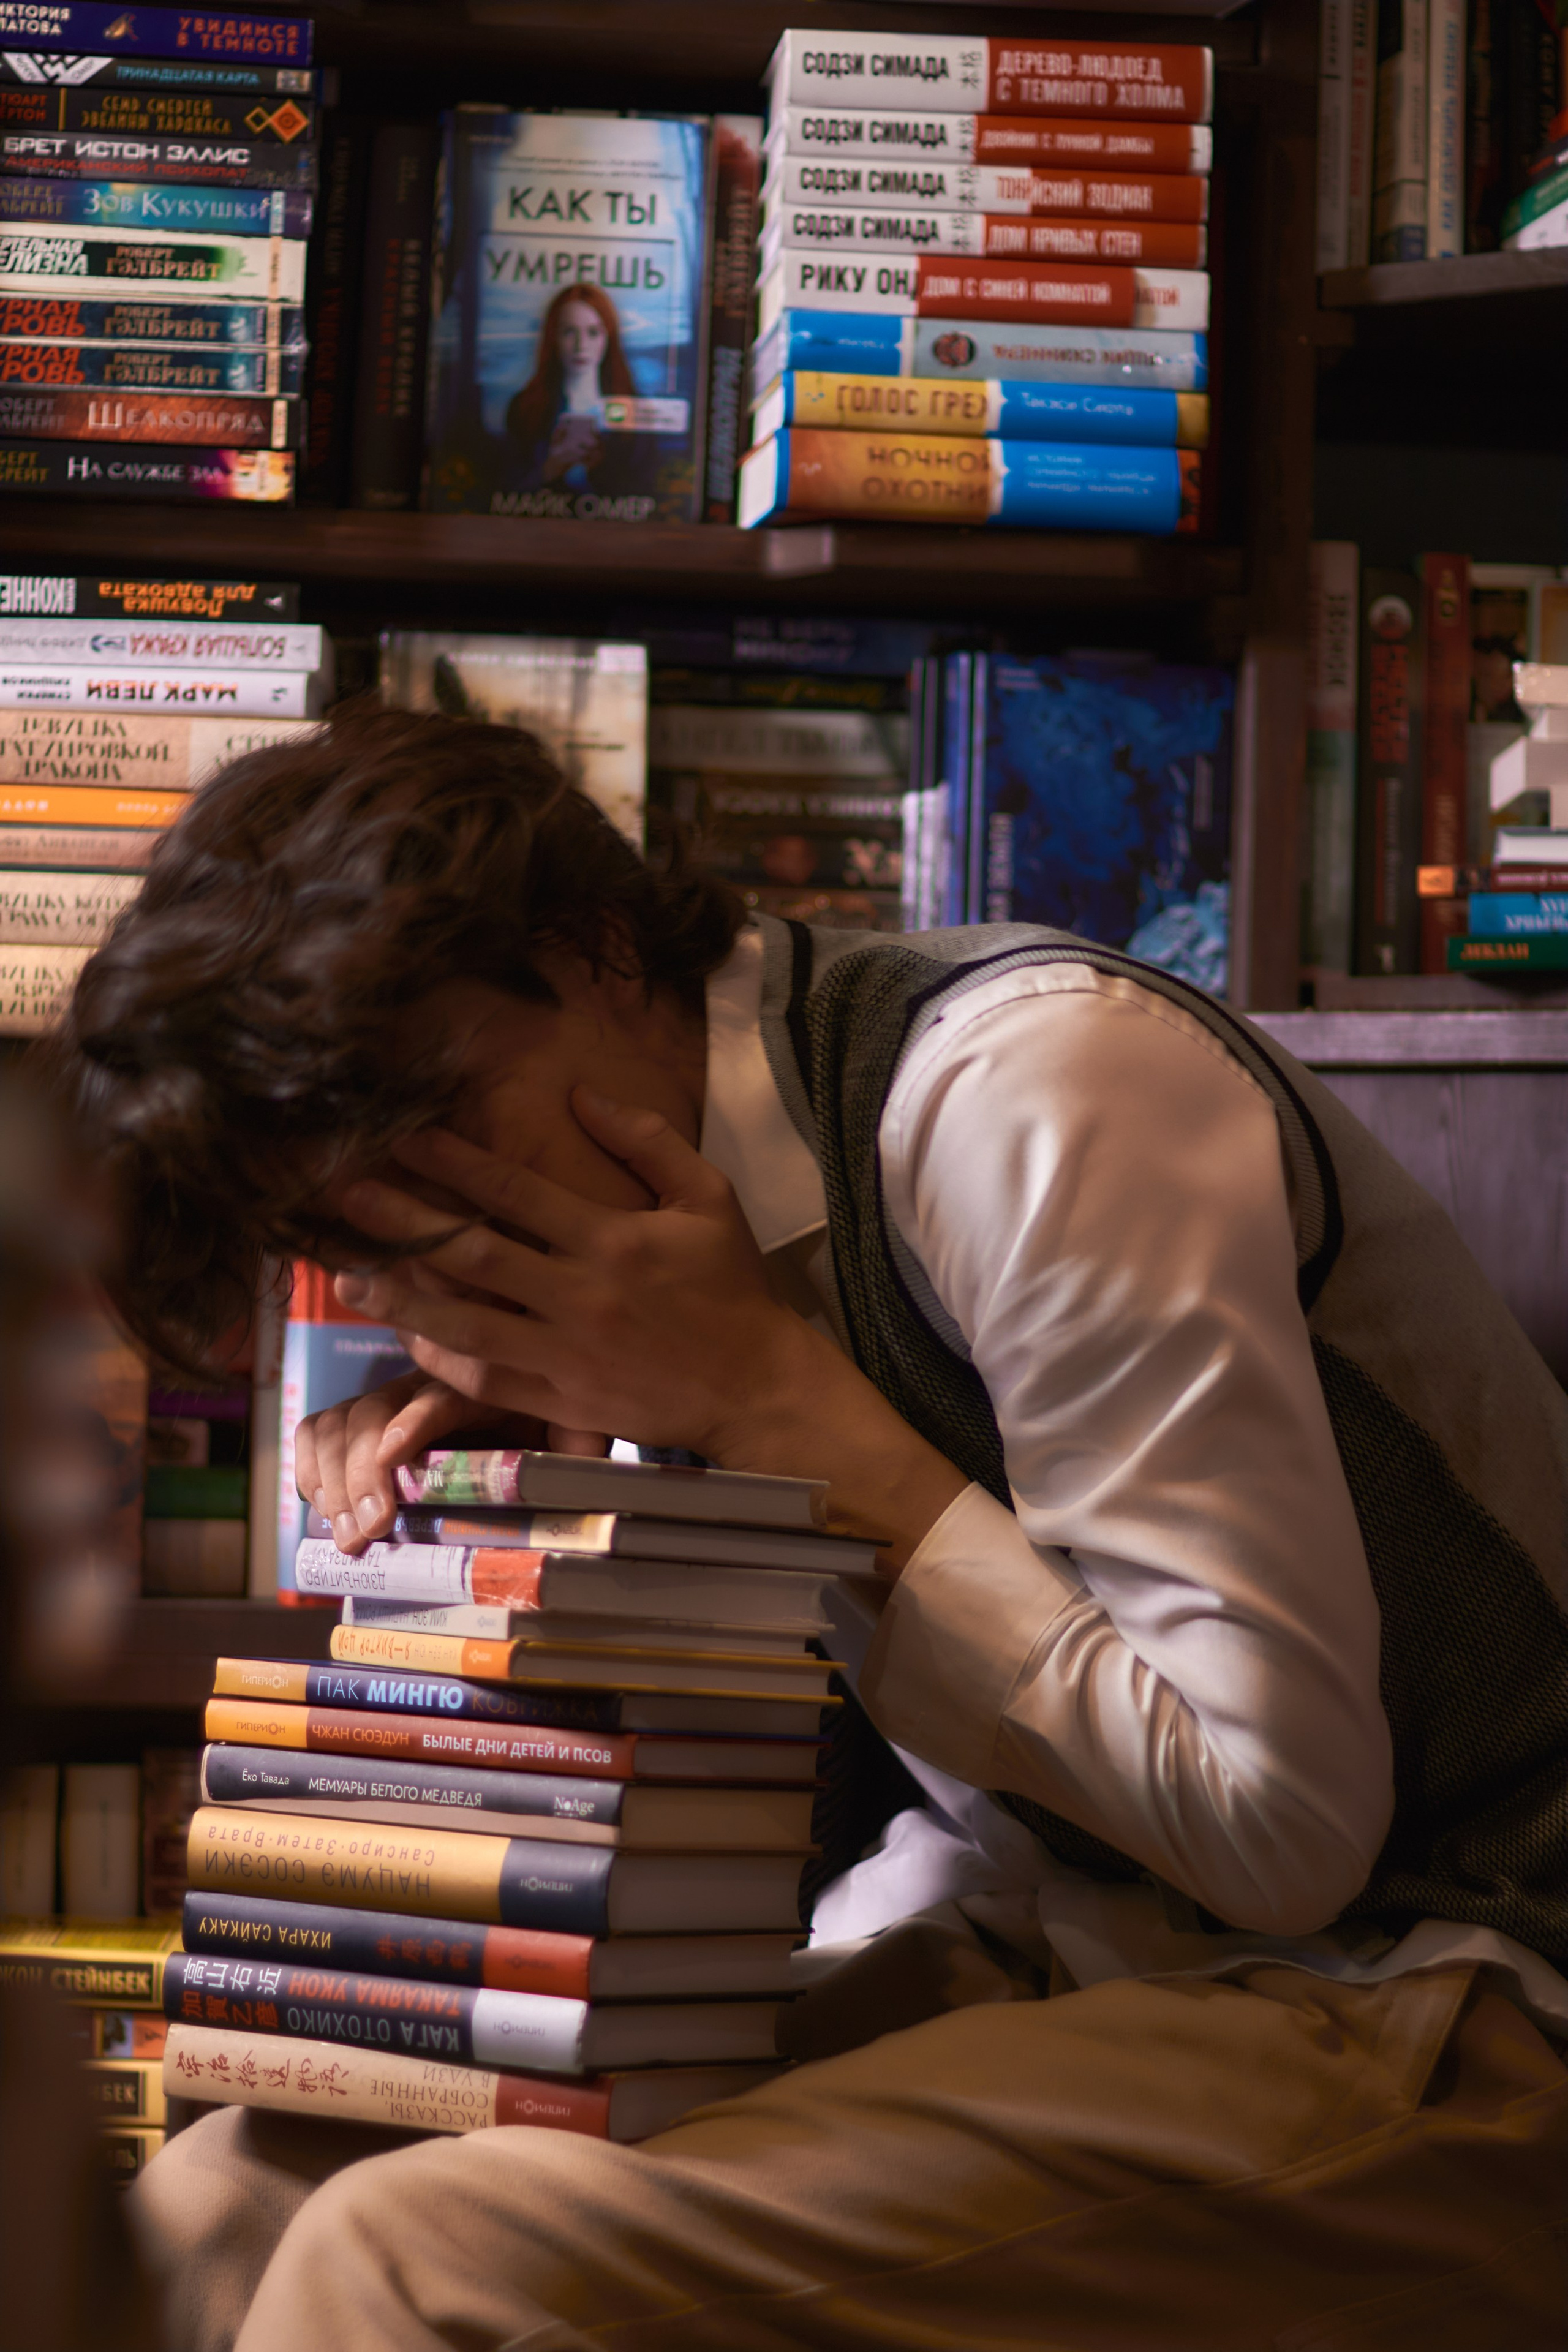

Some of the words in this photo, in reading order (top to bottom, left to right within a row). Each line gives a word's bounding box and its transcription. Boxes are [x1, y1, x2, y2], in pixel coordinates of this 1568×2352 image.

[179, 16, 300, 39] УВИДИМСЯ
[201, 34, 300, 56] ТЕМНОТЕ
[802, 51, 864, 79] СОДЗИ
[870, 53, 949, 82] СИМАДА
[996, 50, 1163, 83] ДЕРЕВО-ЛЮДОЕД
[996, 77, 1012, 102] С
[1020, 79, 1108, 105] ТЕМНОГО
[1114, 83, 1185, 110] ХОЛМА
[802, 118, 862, 146] СОДЗИ
[869, 119, 947, 149] СИМАДА
[3, 137, 67, 154] БРЕТ
[75, 140, 160, 160] ИСТОН
[167, 145, 249, 165] ЭЛЛИС
[800, 167, 861, 195] СОДЗИ
[869, 169, 946, 198] СИМАДА
[508, 186, 592, 222] КАК
[606, 191, 656, 225] ТЫ
[793, 213, 854, 240] СОДЗИ
[861, 215, 940, 244] СИМАДА
[0, 236, 85, 255] РТЕЛЬНАЯ
[484, 249, 666, 291] УМРЕШЬ
[800, 263, 866, 294] РИКУ
[876, 268, 916, 299] ОН
[0, 313, 86, 336] РОВЬ
[0, 361, 86, 384] РОВЬ
[837, 385, 918, 415] ГОЛОС
[99, 581, 206, 601] адвоката
[213, 582, 257, 602] для
[123, 596, 225, 617] Ловушка
[194, 633, 287, 658] БОЛЬШАЯ
[86, 678, 158, 702] ЛЕВИ
[164, 679, 239, 703] МАРК
[395, 1515, 442, 1534] ДЕРЕВЬЯ
[306, 1570, 385, 1591] ДЗЮНЪИТИРО
[430, 1610, 448, 1627] КИМ
[241, 1675, 288, 1690] ГИПЕРИОН
[317, 1676, 360, 1701] ПАК
[367, 1679, 464, 1710] МИНГЮ
[236, 1721, 286, 1736] ГИПЕРИОН
[312, 1724, 350, 1741] ЧЖАН
[353, 1727, 409, 1746] СЮЭДУН
[423, 1733, 472, 1753] БЫЛЫЕ
[475, 1738, 507, 1758] ДНИ
[510, 1740, 555, 1761] ДЕТЕЙ
[559, 1746, 570, 1760] И
[573, 1747, 611, 1764] ПСОВ
[242, 1768, 258, 1783] Ёко
[260, 1770, 290, 1787] Тавада
[308, 1776, 368, 1796] МЕМУАРЫ
[371, 1782, 418, 1802] БЕЛОГО
[421, 1787, 482, 1809] МЕДВЕДЯ
[204, 1849, 305, 1884] СОСЭКИ
[321, 1860, 431, 1896] НАЦУМЭ
[519, 1876, 573, 1894] ГИПЕРИОН
[198, 1917, 271, 1943] САЙКАКУ
[279, 1926, 331, 1950] ИХАРА
[183, 1957, 282, 1996] 高山右近
[287, 1971, 348, 2002] УКОН
[355, 1977, 461, 2017] ТАКАЯМА
[287, 2007, 391, 2043] ОТОХИКО
[399, 2019, 460, 2052] КАГА
[423, 2065, 475, 2087] УДЗИ
[369, 2078, 490, 2109] СОБРАННЫЕ
[514, 2100, 571, 2118] ГИПЕРИОН
